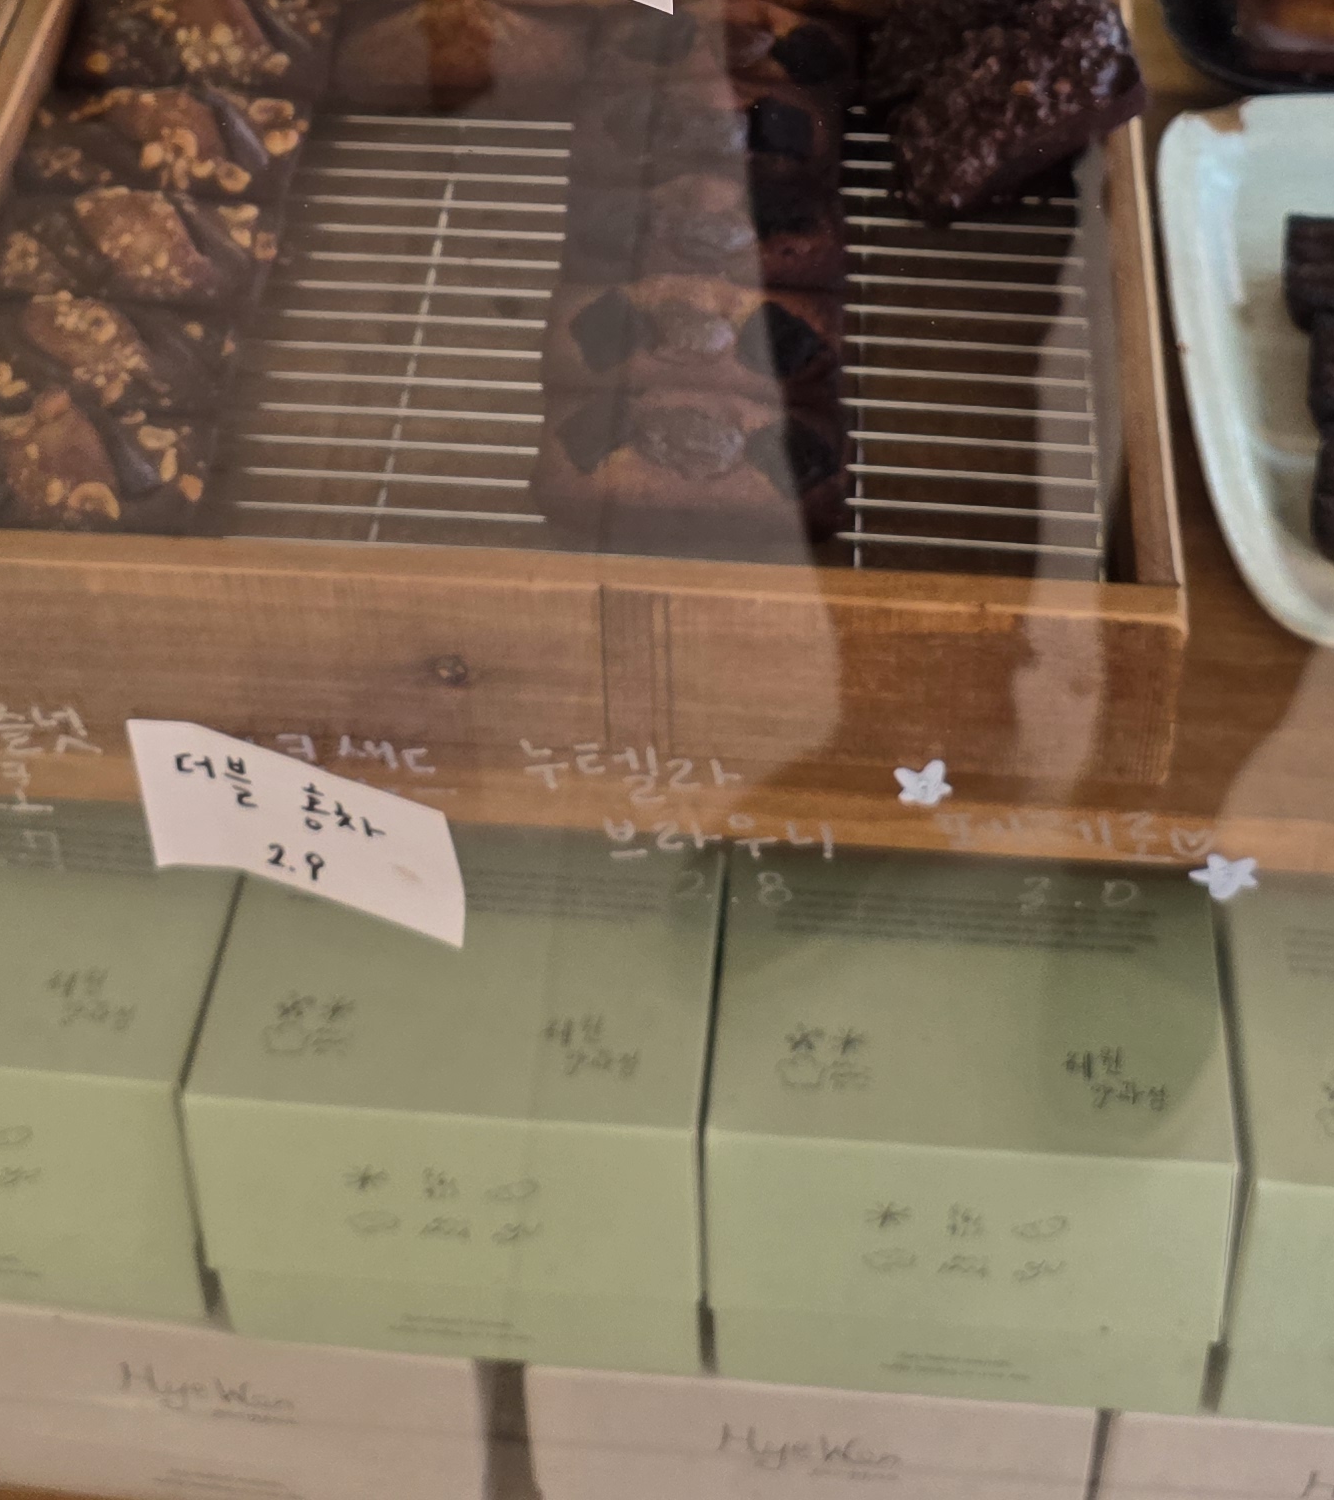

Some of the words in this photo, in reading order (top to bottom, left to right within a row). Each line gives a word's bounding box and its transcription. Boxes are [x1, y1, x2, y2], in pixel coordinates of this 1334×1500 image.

[174, 752, 260, 808] 더블
[301, 782, 386, 838] 홍차
[519, 737, 743, 806] 누텔라
[267, 843, 326, 881] 2.9
[602, 811, 835, 862] 브라우니
